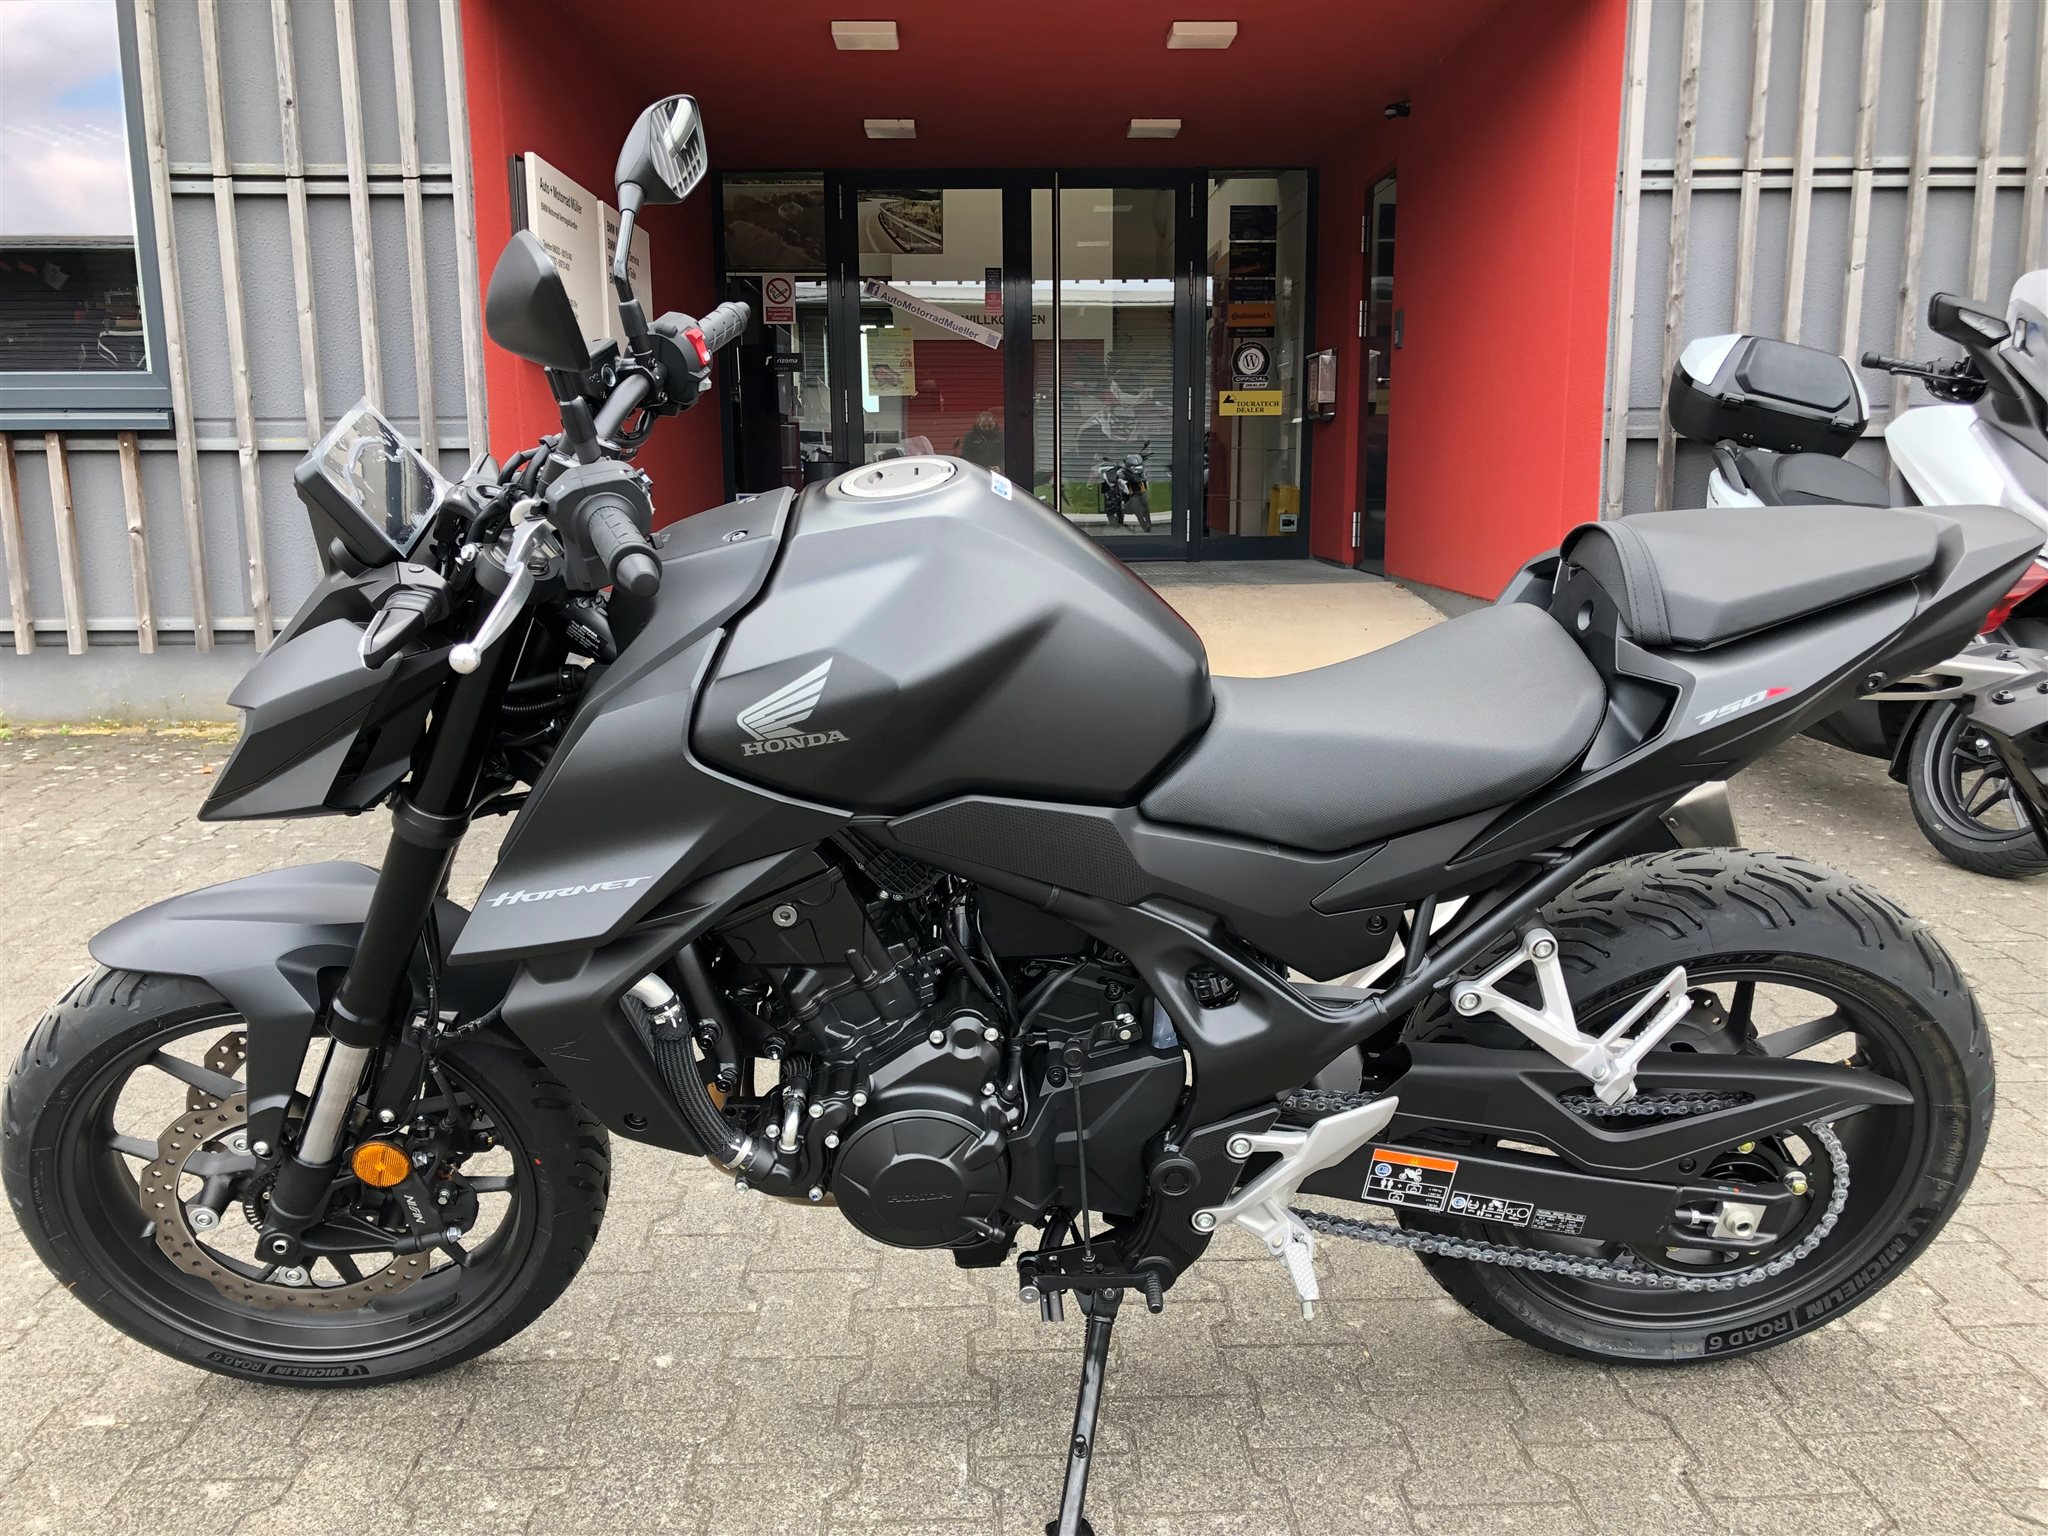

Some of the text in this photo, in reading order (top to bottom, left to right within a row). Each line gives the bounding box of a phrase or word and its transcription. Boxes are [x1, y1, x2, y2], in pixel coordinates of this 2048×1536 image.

[539, 177, 550, 192] Auto
[553, 185, 571, 208] Motorrad
[880, 291, 980, 339] AutoMotorradMueller
[1231, 313, 1266, 321] Continental
[776, 356, 798, 364] rizoma
[1695, 689, 1768, 725] 750
[741, 730, 850, 756] HONDA
[486, 875, 654, 908] HORNET
[1805, 1236, 1908, 1320] MICHELIN
[1708, 1335, 1723, 1351] 6
[1728, 1315, 1790, 1347] ROAD
[212, 1352, 346, 1377] MICHELIN ROAD 6
